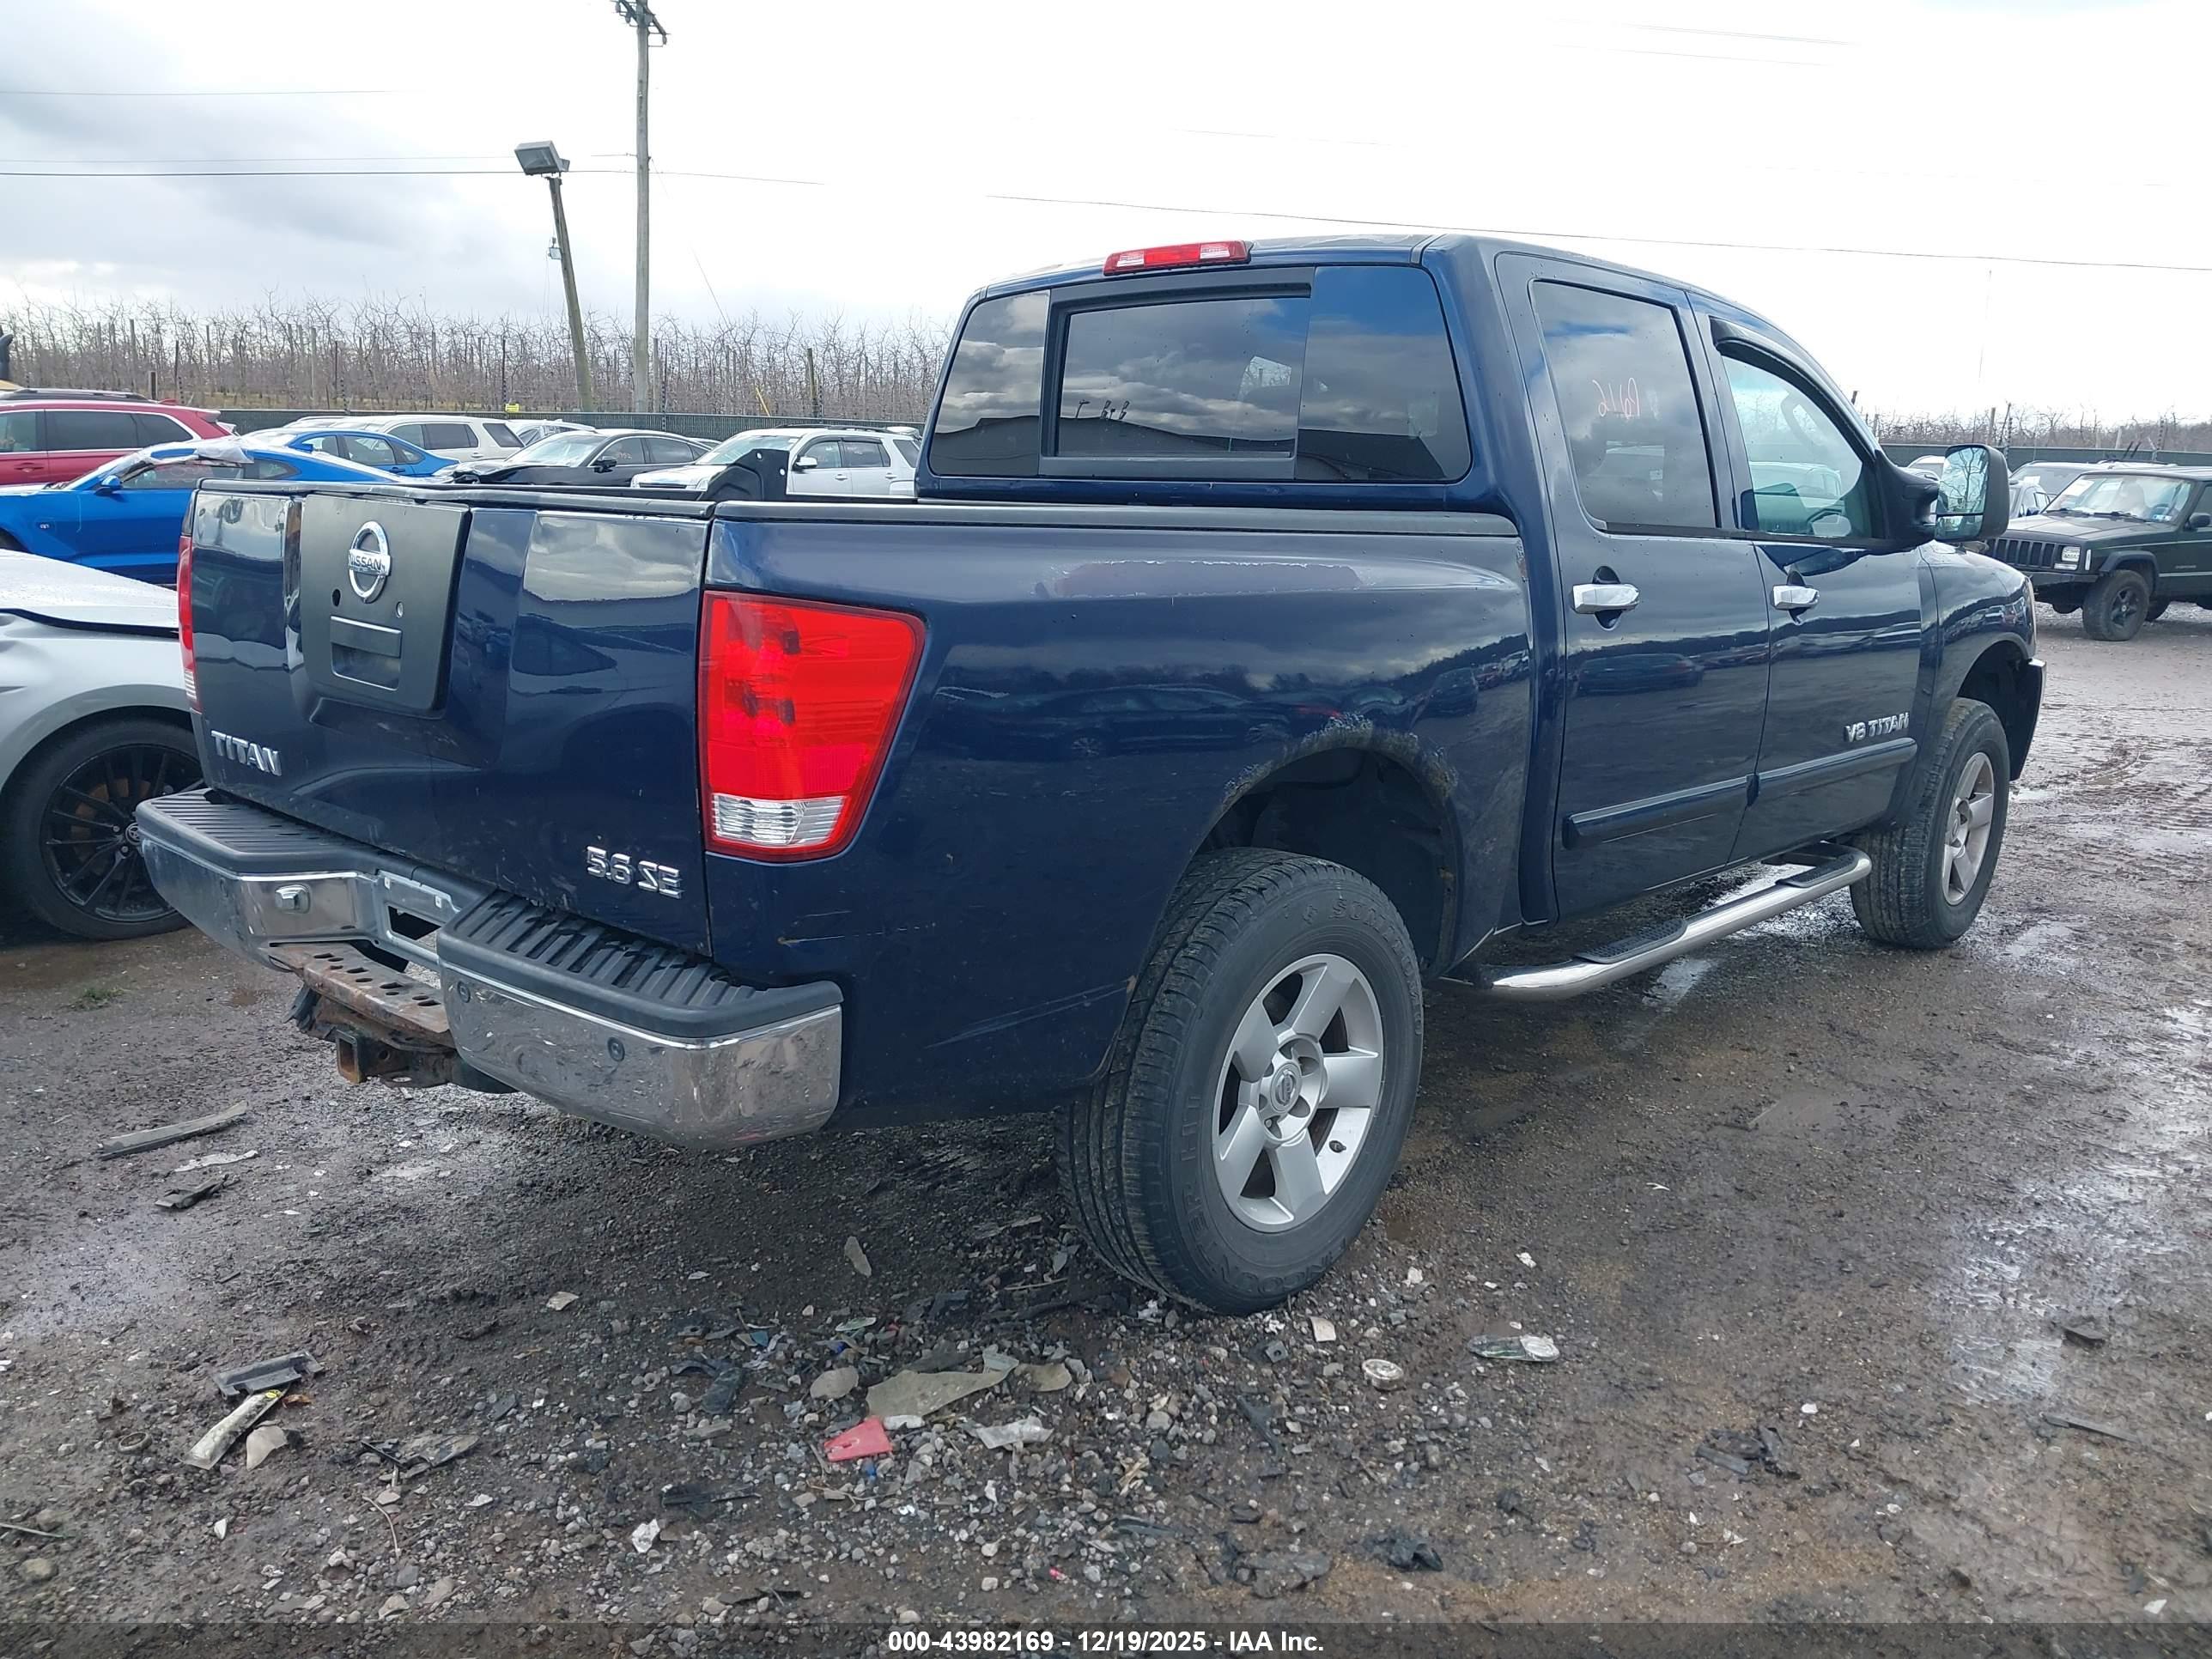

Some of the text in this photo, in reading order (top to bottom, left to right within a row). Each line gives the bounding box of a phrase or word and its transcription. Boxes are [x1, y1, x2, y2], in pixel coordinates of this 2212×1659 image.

[348, 552, 382, 572] NISSAN
[1844, 712, 1910, 743] V8 TITAN
[210, 730, 283, 777] TITAN
[586, 846, 684, 899] 5.6 SE
